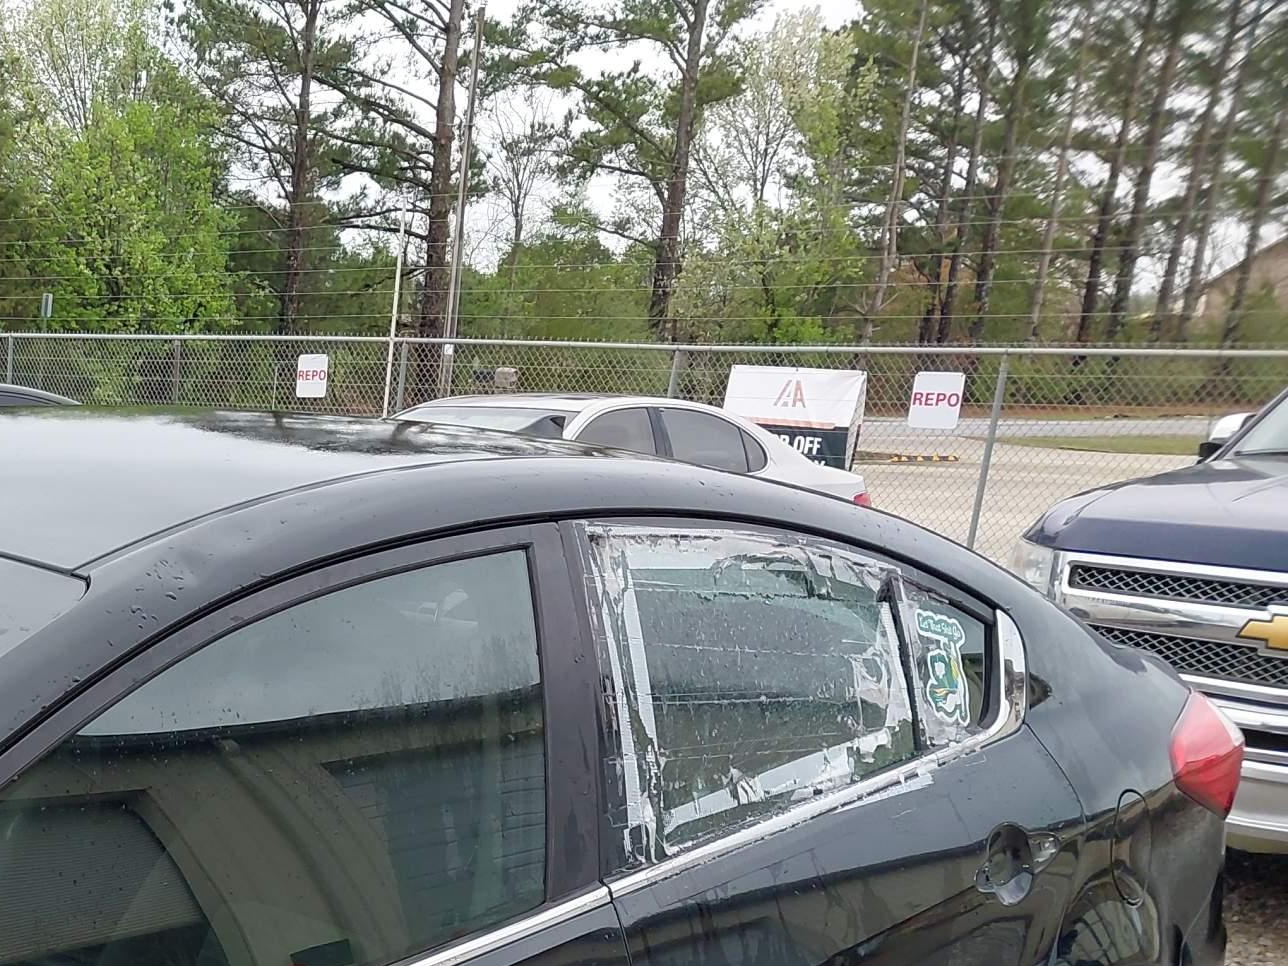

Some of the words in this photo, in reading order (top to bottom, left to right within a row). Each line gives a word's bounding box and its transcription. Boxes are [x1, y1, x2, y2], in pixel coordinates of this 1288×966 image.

[297, 370, 326, 381] REPO
[912, 392, 960, 407] REPO
[793, 436, 822, 455] OFF
